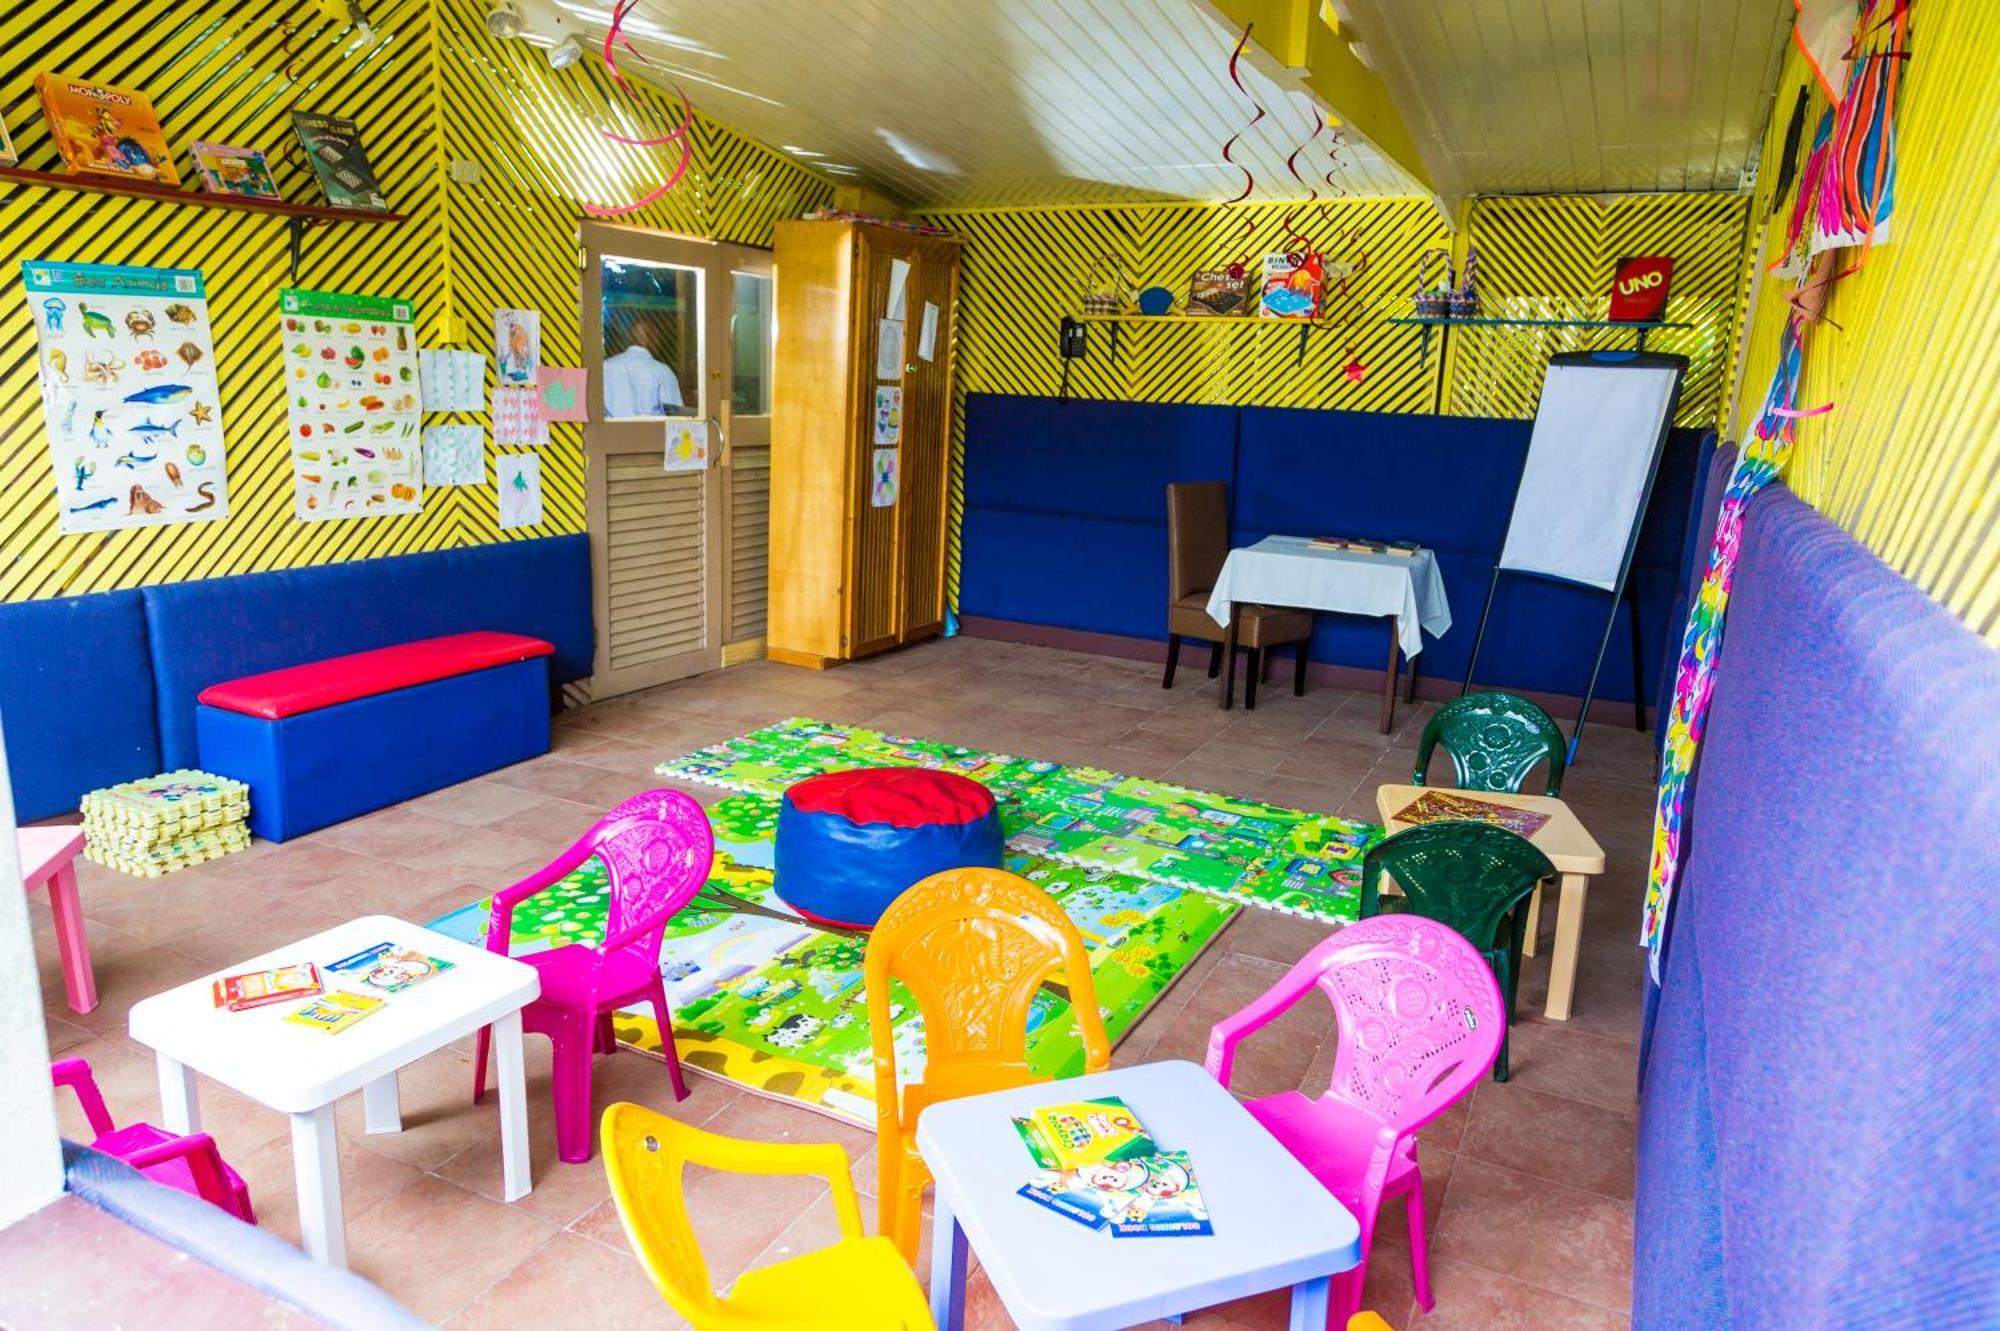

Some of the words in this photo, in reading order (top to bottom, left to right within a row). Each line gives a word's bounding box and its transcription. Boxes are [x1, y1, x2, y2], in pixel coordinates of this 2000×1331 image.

[69, 84, 131, 105] MONOPOLY
[1201, 271, 1236, 281] Ches
[1619, 271, 1663, 295] UNO
